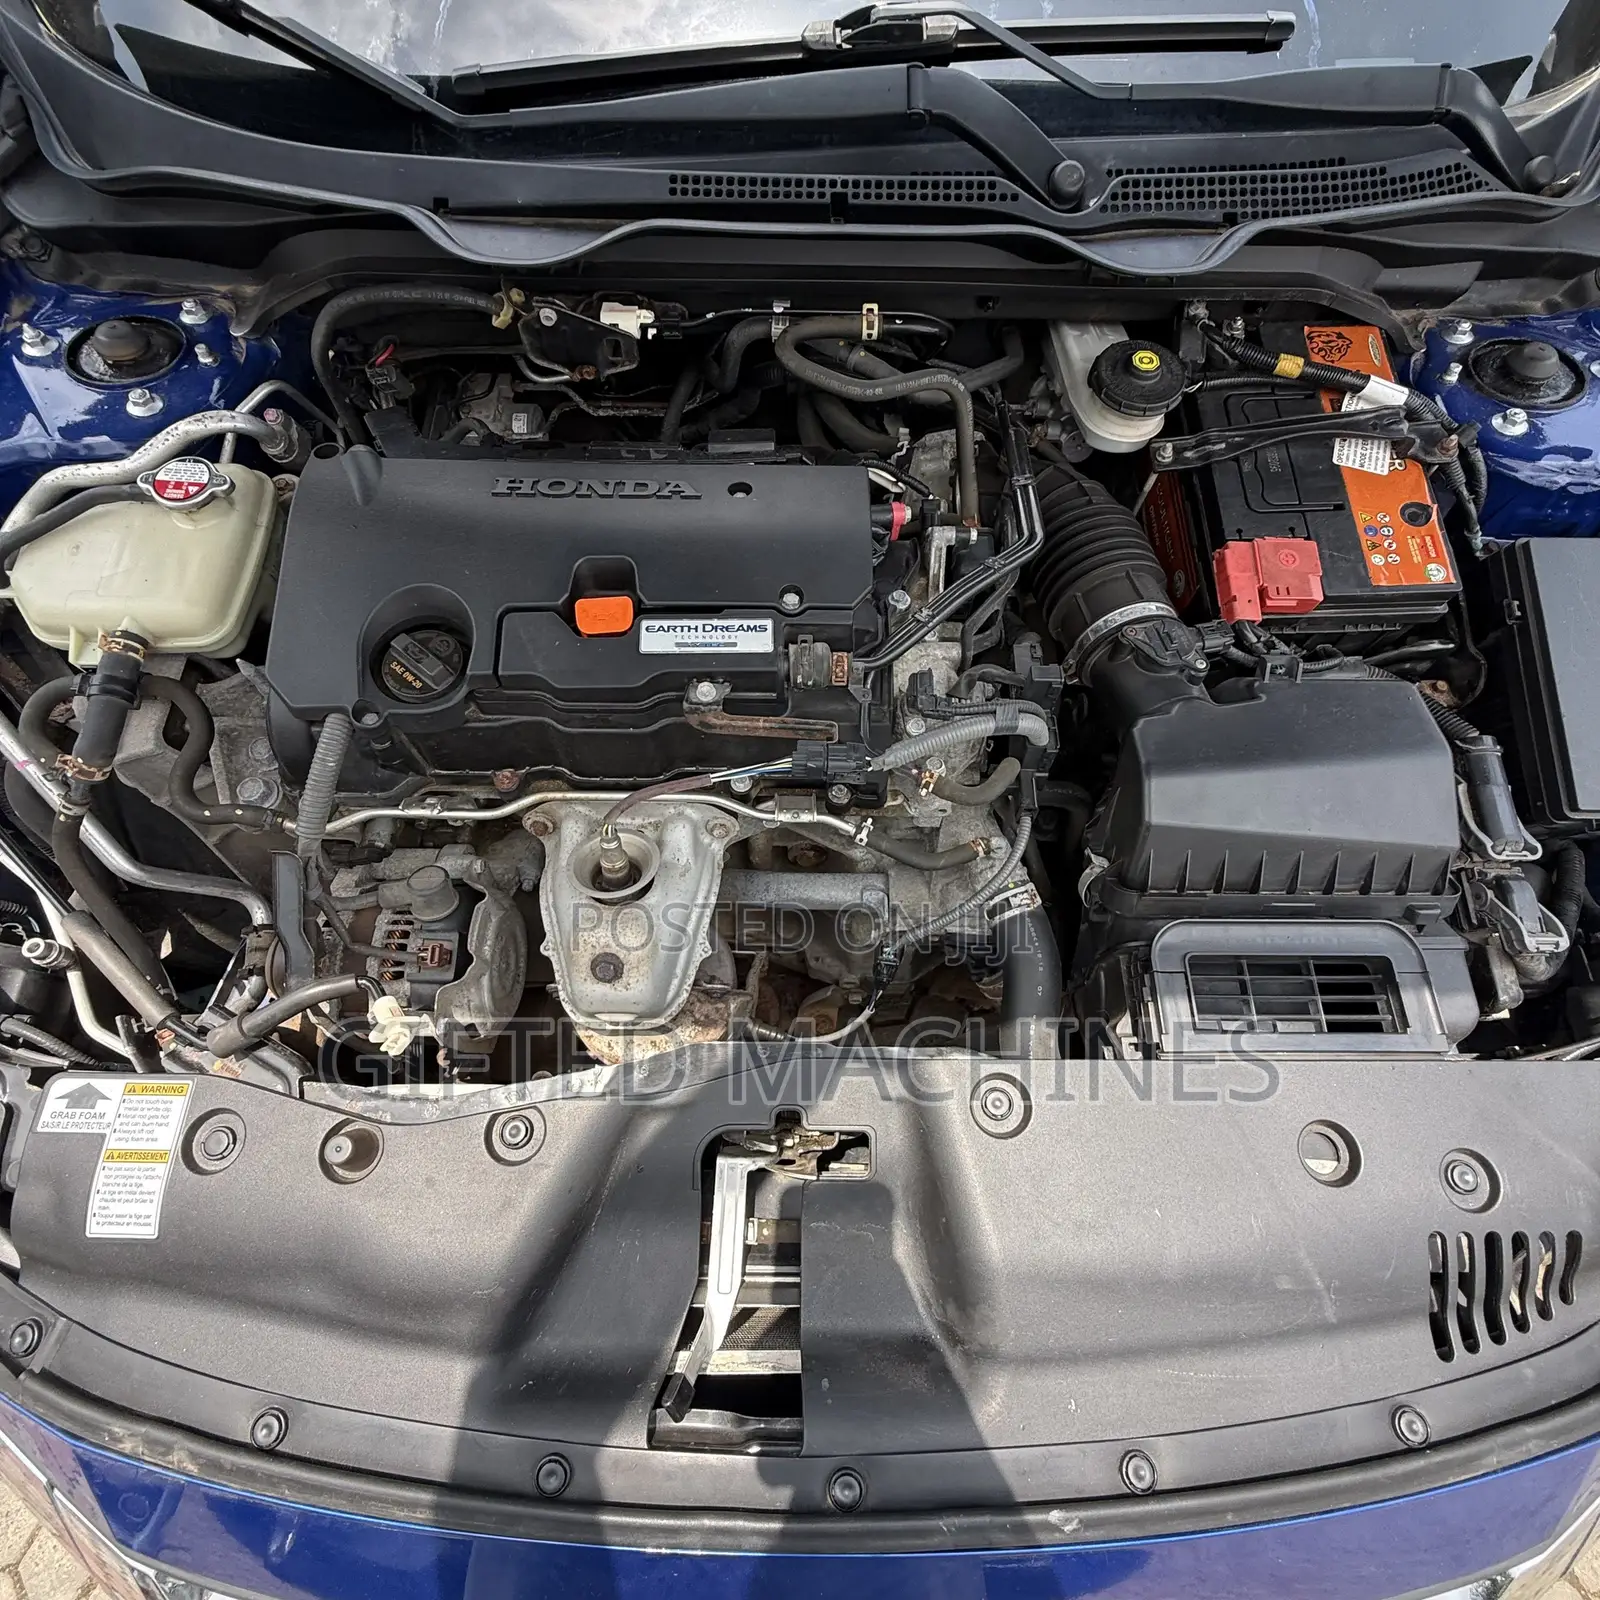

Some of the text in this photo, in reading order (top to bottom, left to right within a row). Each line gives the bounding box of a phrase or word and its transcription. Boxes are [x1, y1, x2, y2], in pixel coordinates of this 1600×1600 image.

[491, 477, 702, 500] HONDA
[644, 624, 768, 632] EARTH DREAMS
[390, 661, 406, 675] SAE
[141, 1086, 184, 1094] WARNING
[50, 1111, 106, 1120] GRAB FOAM
[70, 1122, 112, 1130] PROTECTEUR
[116, 1152, 168, 1160] AVERTISSEMENT
